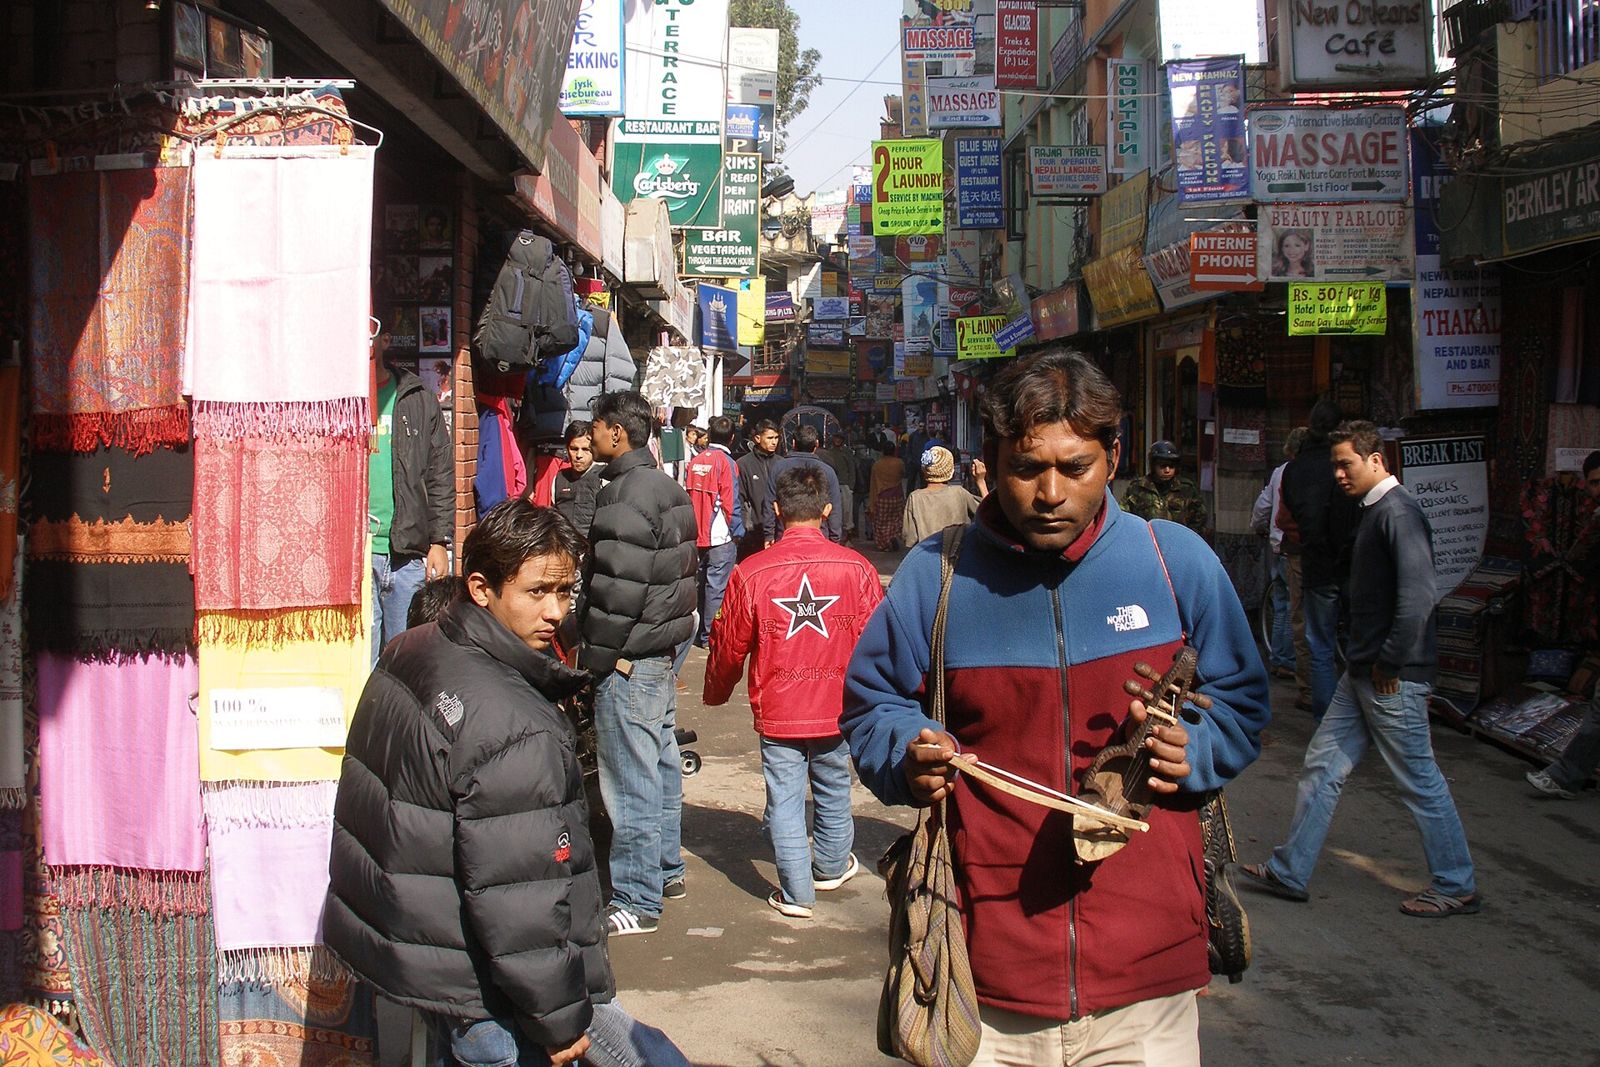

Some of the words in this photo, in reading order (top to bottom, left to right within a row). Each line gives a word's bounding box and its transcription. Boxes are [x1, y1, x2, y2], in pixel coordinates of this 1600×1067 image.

[1296, 2, 1340, 26] New
[1346, 1, 1421, 25] Orleans
[1003, 14, 1031, 31] GLACIER
[906, 29, 973, 49] MASSAGE
[1004, 37, 1023, 45] Treks
[998, 46, 1036, 57] Expedition
[566, 51, 619, 70] EKKING
[661, 9, 681, 115] TERRACE
[1017, 58, 1030, 66] Ltd.
[574, 79, 593, 91] jysk
[559, 88, 613, 100] ejsebureau
[930, 92, 997, 112] MASSAGE
[1287, 114, 1341, 129] Alternative
[1341, 113, 1374, 129] Healing
[1373, 113, 1401, 126] Center
[625, 121, 694, 134] RESTAURANT
[696, 122, 717, 134] BAR
[959, 141, 980, 152] BLUE
[982, 140, 998, 152] SKY
[1255, 132, 1399, 168] MASSAGE
[1070, 148, 1102, 157] TRAVEL
[959, 156, 978, 167] GUEST
[980, 155, 999, 166] HOUSE
[875, 146, 891, 203] 2
[892, 157, 923, 170] HOUR
[1034, 166, 1061, 174] NEPALI
[1064, 166, 1102, 174] LANGUAGE
[1329, 170, 1348, 179] Care
[1348, 169, 1367, 178] Foot
[731, 173, 757, 182] READ
[893, 173, 942, 188] LAUNDRY
[960, 177, 999, 186] RESTAURANT
[633, 173, 698, 197] Carlsberg
[1325, 182, 1350, 192] Floor
[890, 194, 911, 203] SERVICE
[913, 193, 919, 202] BY
[920, 192, 943, 201] MACHINE
[1506, 170, 1572, 224] BERKLEY
[1576, 163, 1600, 207] AR
[1271, 210, 1330, 227] BEAUTY
[1336, 209, 1408, 226] PARLOUR
[702, 230, 742, 242] BAR
[909, 236, 926, 245] PUB
[1194, 237, 1257, 250] INTERNE
[690, 245, 752, 256] VEGETARIAN
[687, 256, 712, 266] THROUGH
[713, 256, 722, 266] THE
[723, 256, 737, 266] BOOK
[737, 256, 755, 266] HOUSE
[1199, 255, 1255, 268] PHONE
[1420, 271, 1452, 282] NEWA
[1293, 288, 1312, 301] Rs.
[1369, 286, 1381, 302] Kg
[1423, 287, 1459, 299] NEPALI
[1294, 303, 1316, 314] Hotel
[1356, 302, 1378, 313] Home
[1293, 318, 1315, 328] Same
[1318, 318, 1333, 329] Day
[1335, 317, 1366, 329] Laundry
[958, 320, 968, 351] 2
[1434, 346, 1500, 357] RESTAURANT
[1446, 360, 1467, 370] AND
[1470, 359, 1491, 370] BAR
[1451, 384, 1465, 393] Ph:
[1403, 443, 1450, 466] BREAK
[1453, 440, 1485, 462] FAST
[1415, 480, 1459, 495] BAGELS
[797, 603, 816, 617] M
[1116, 606, 1133, 616] THE
[761, 619, 778, 633] B
[833, 615, 856, 630] W
[1106, 613, 1134, 625] NORTH
[1115, 622, 1136, 632] FACE
[774, 667, 843, 682] RACING
[213, 699, 242, 714] 100
[248, 699, 267, 713] %
